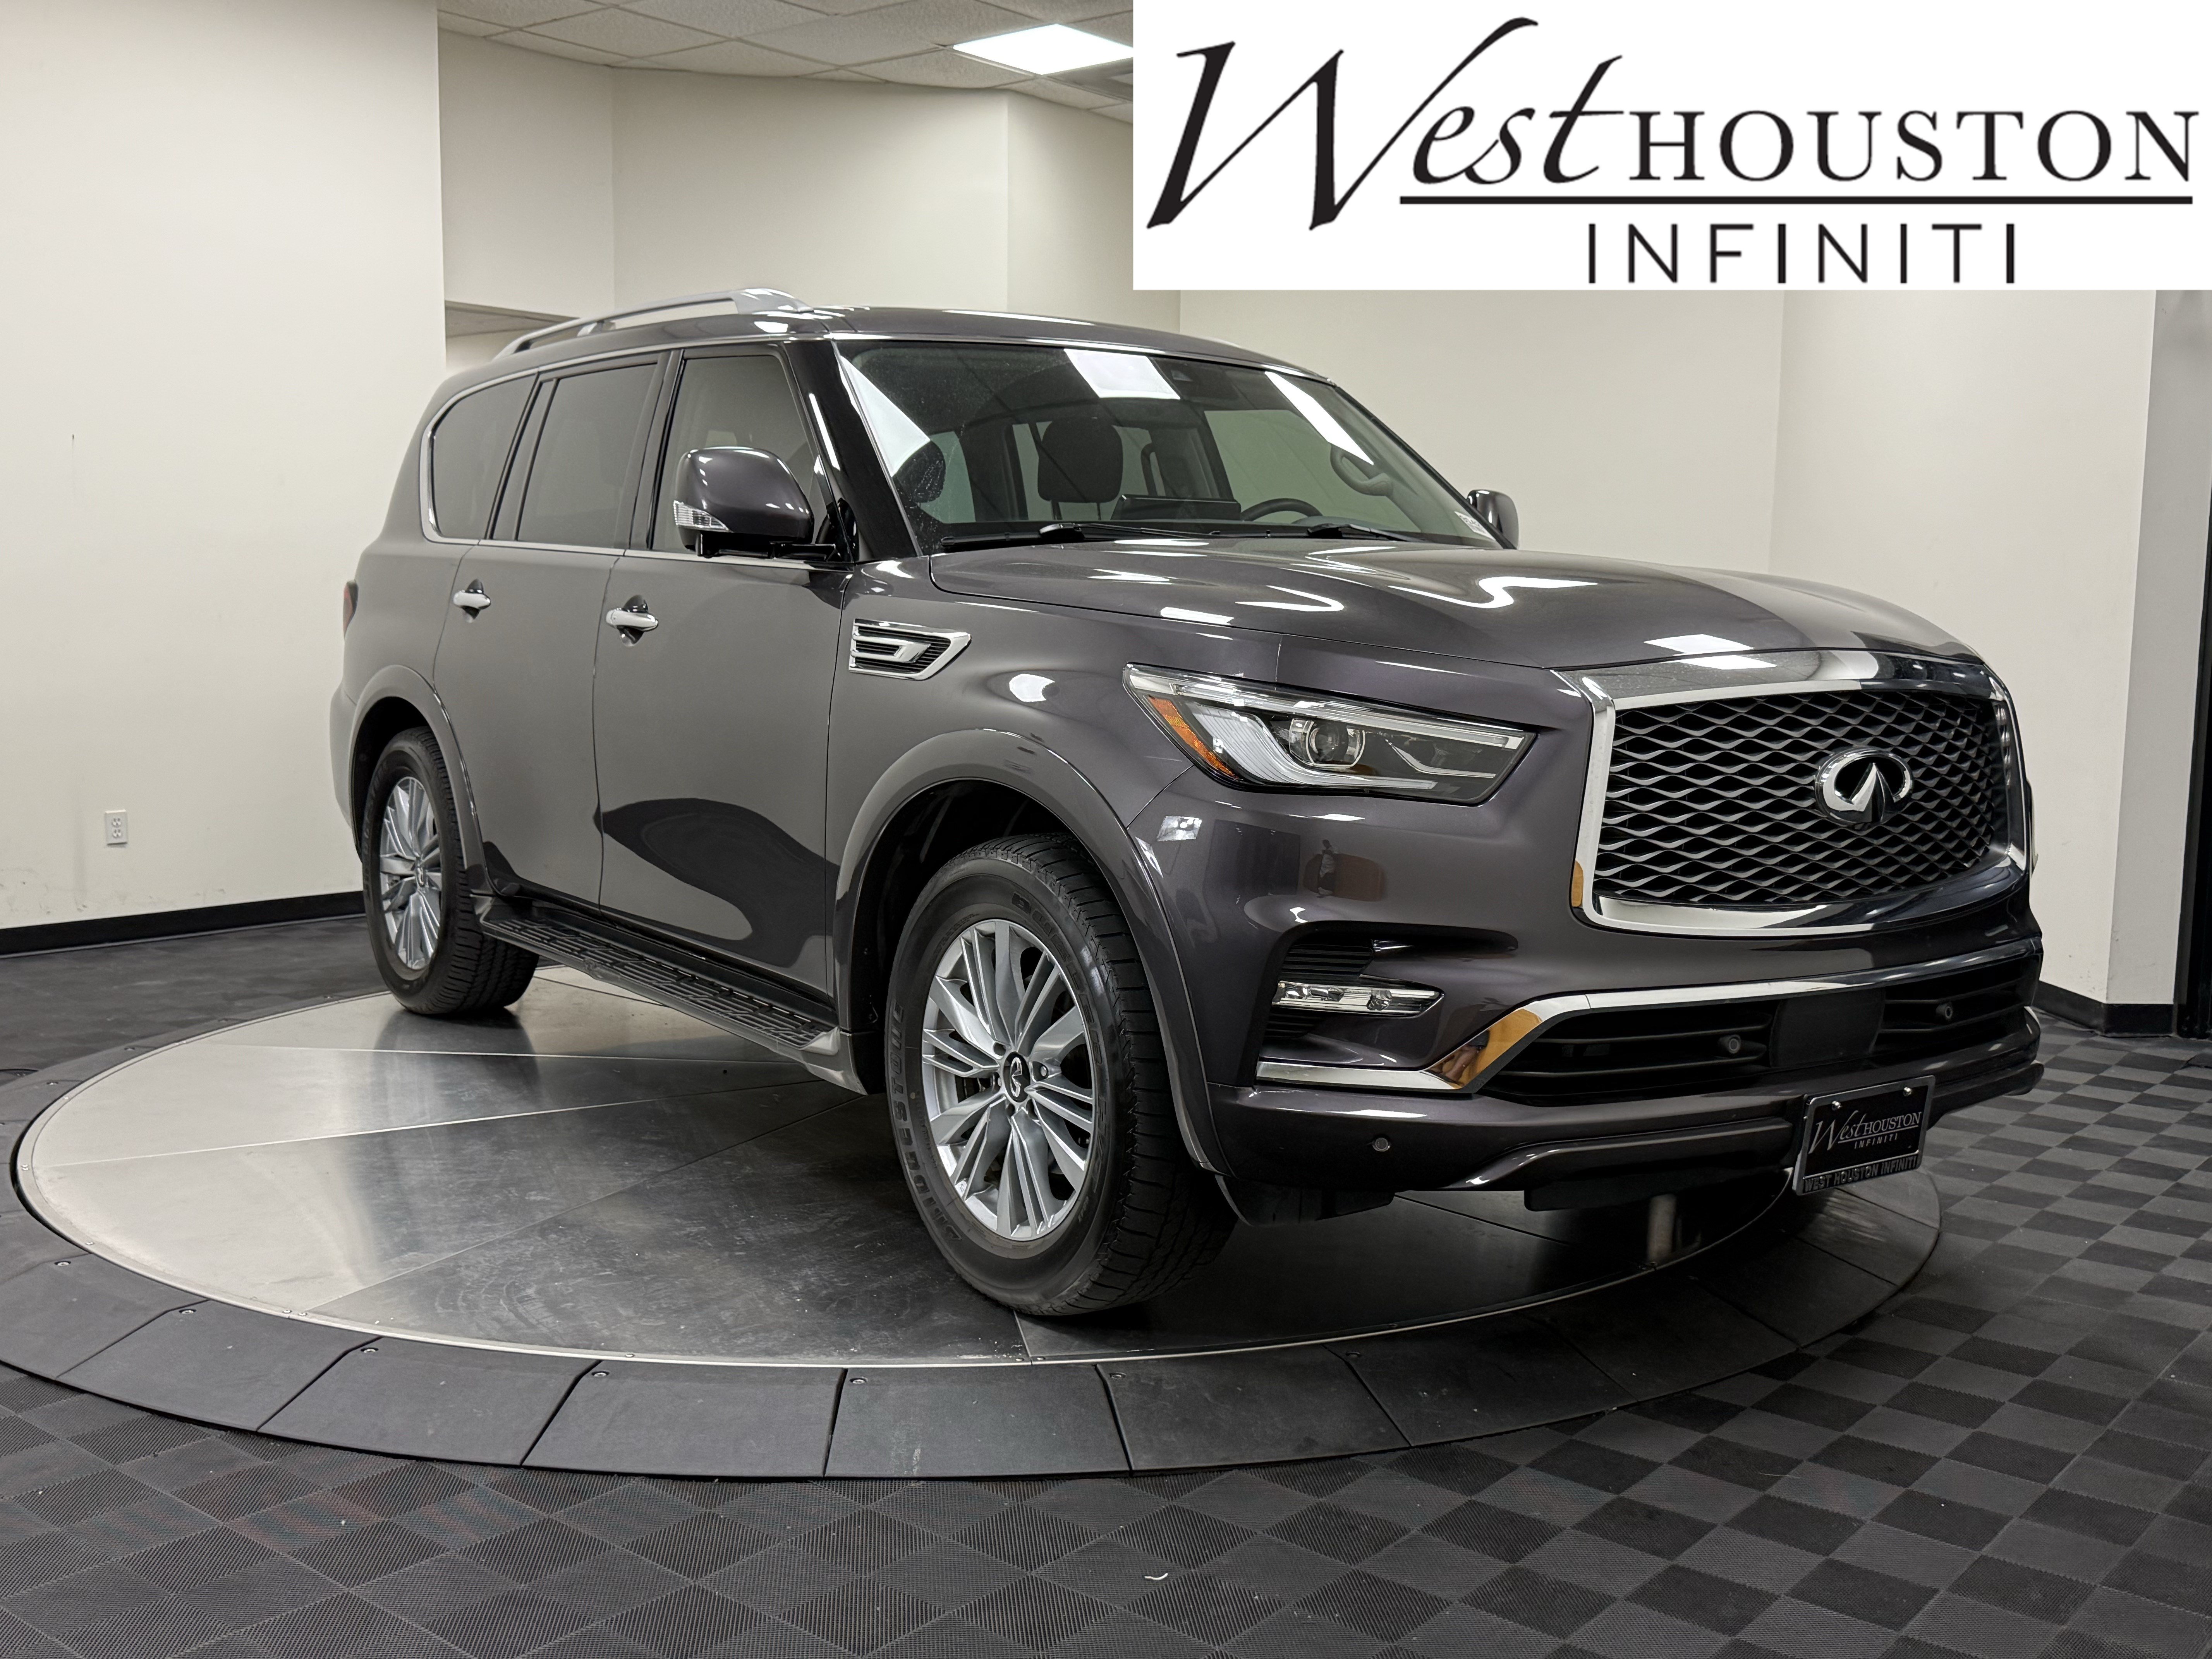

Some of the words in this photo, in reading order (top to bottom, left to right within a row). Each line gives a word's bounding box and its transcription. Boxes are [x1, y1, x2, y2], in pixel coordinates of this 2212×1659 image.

[1808, 1110, 1867, 1154] West
[1862, 1111, 1922, 1135] HOUSTON
[1854, 1133, 1898, 1149] INFINITI
[1805, 1175, 1832, 1192] WEST
[1834, 1163, 1879, 1185] HOUSTON
[1880, 1156, 1918, 1175] INFINITI
